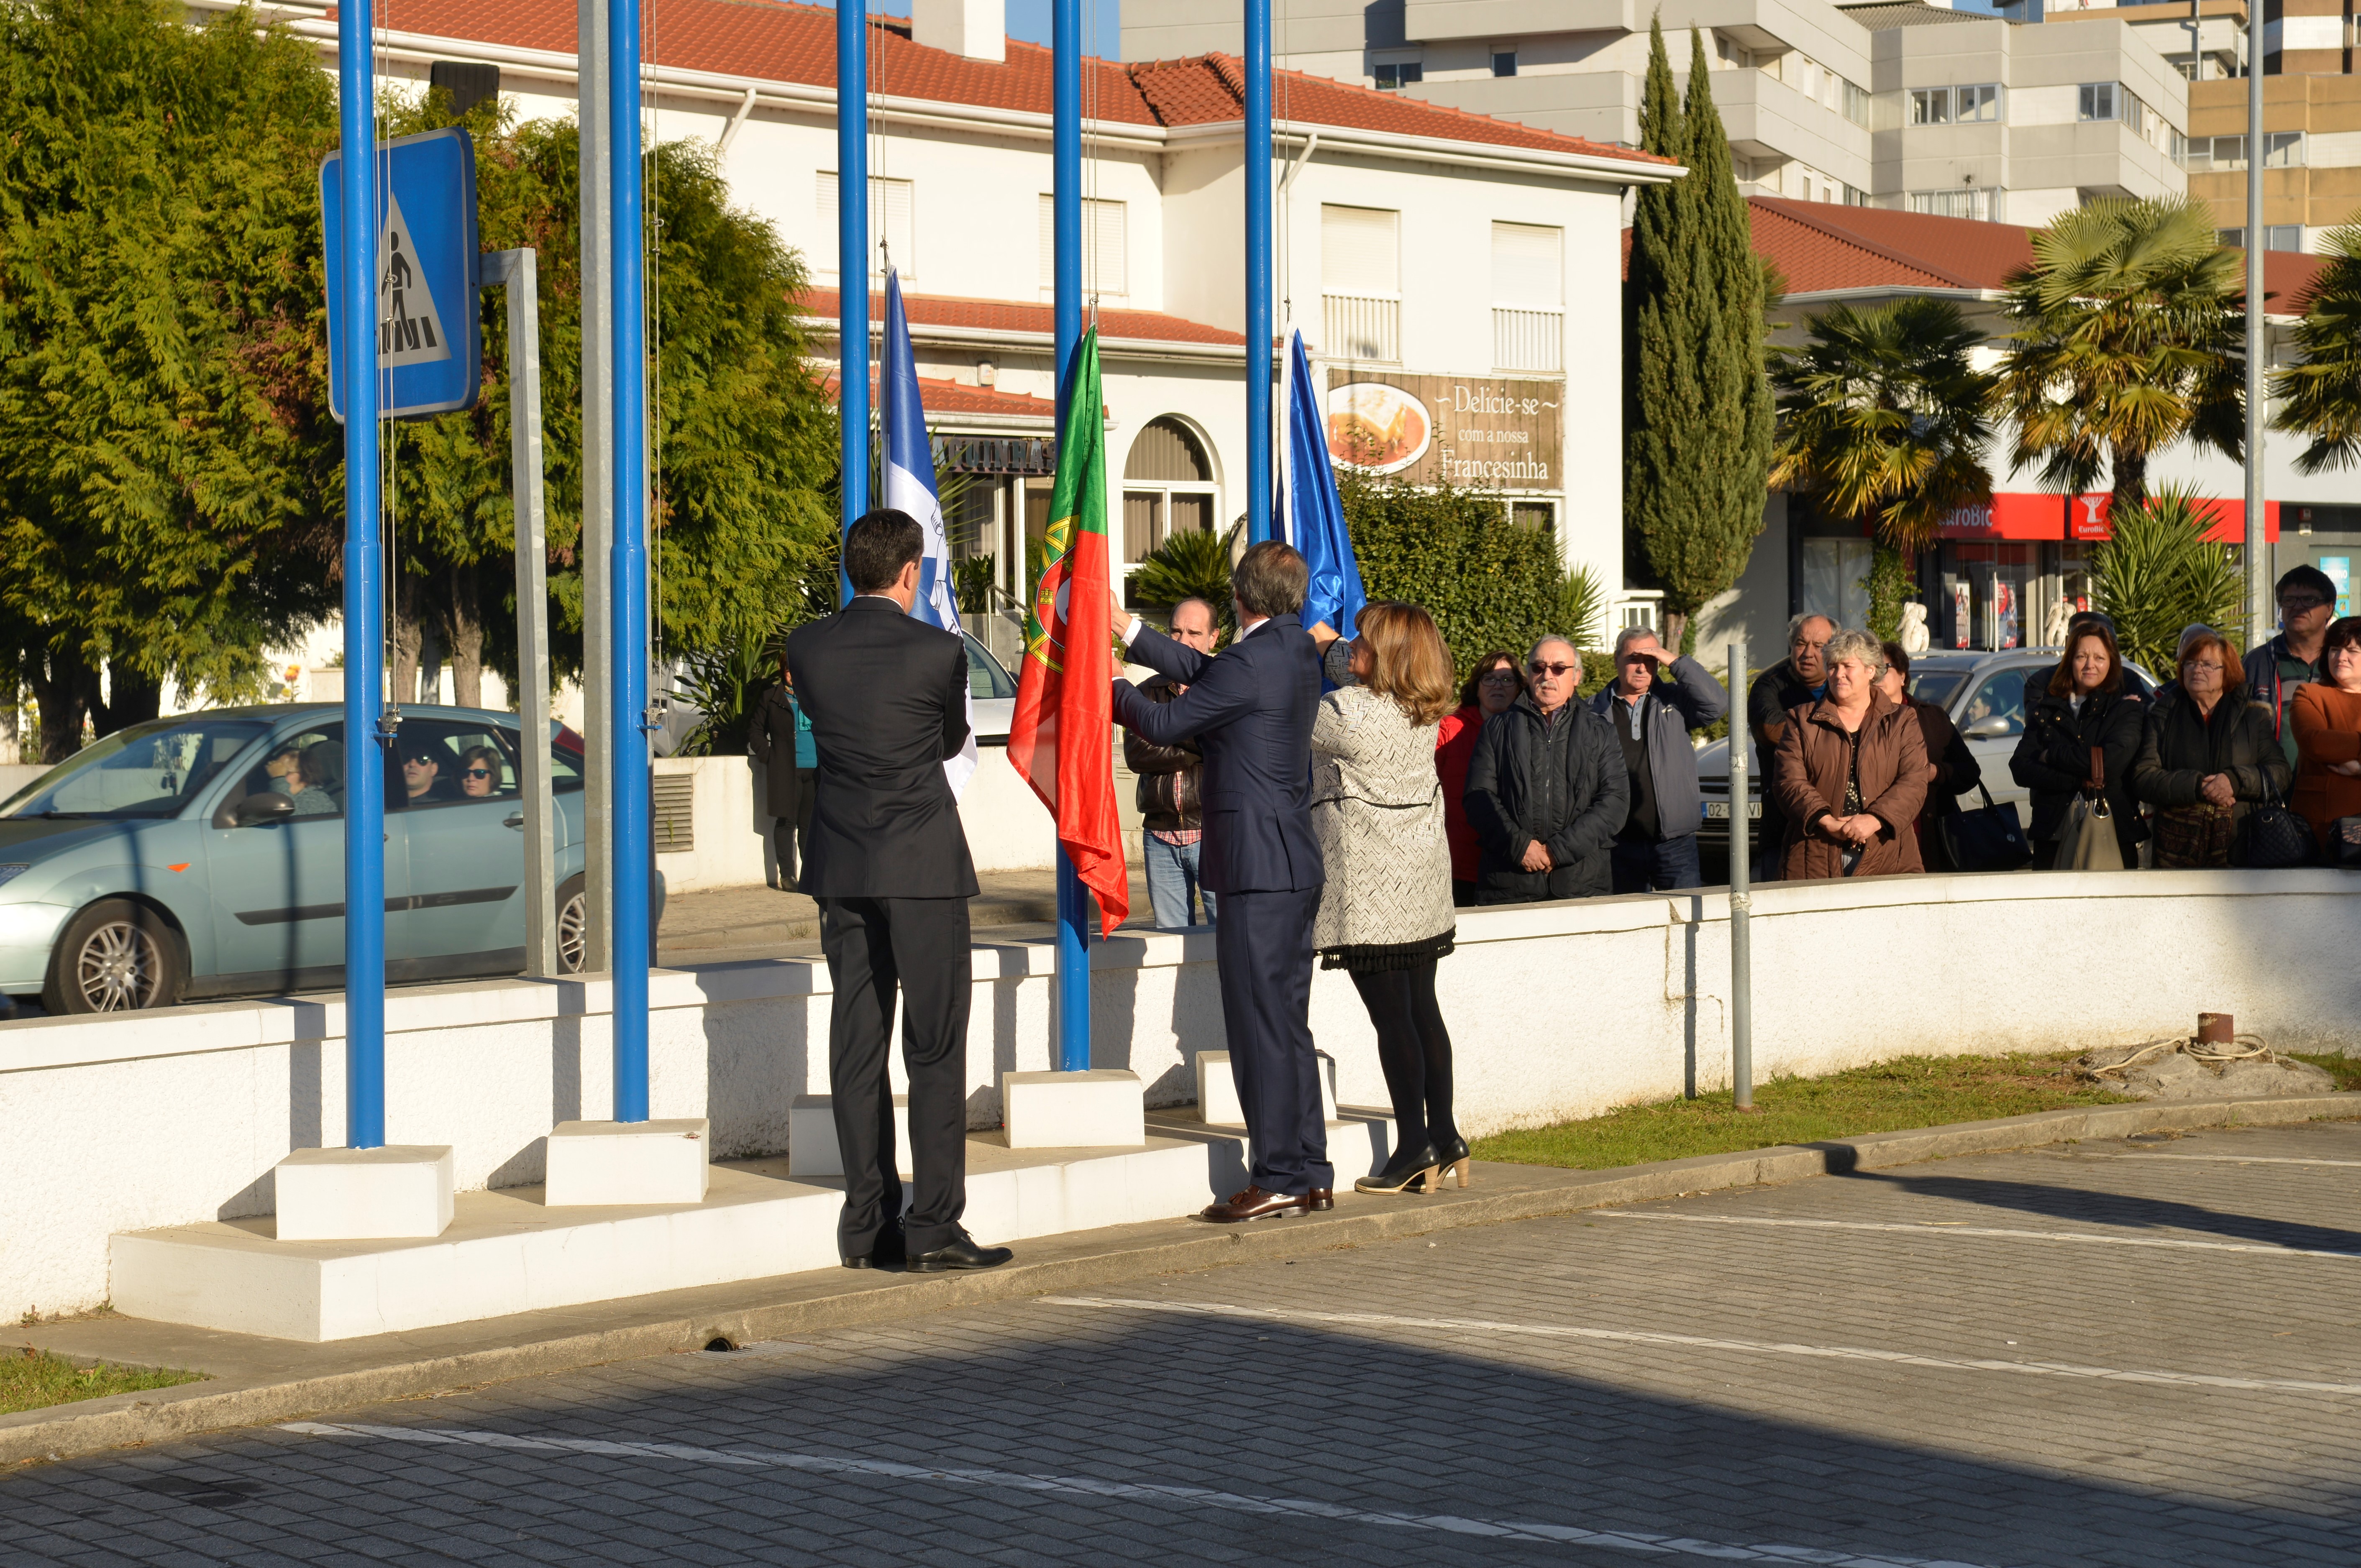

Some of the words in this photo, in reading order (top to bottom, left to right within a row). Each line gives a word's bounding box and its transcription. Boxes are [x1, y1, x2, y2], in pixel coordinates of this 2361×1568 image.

[1454, 385, 1539, 415] Delicie-se
[1459, 429, 1483, 442] com
[1487, 430, 1493, 442] a
[1496, 431, 1529, 443] nossa
[1440, 449, 1548, 479] Francesinha
